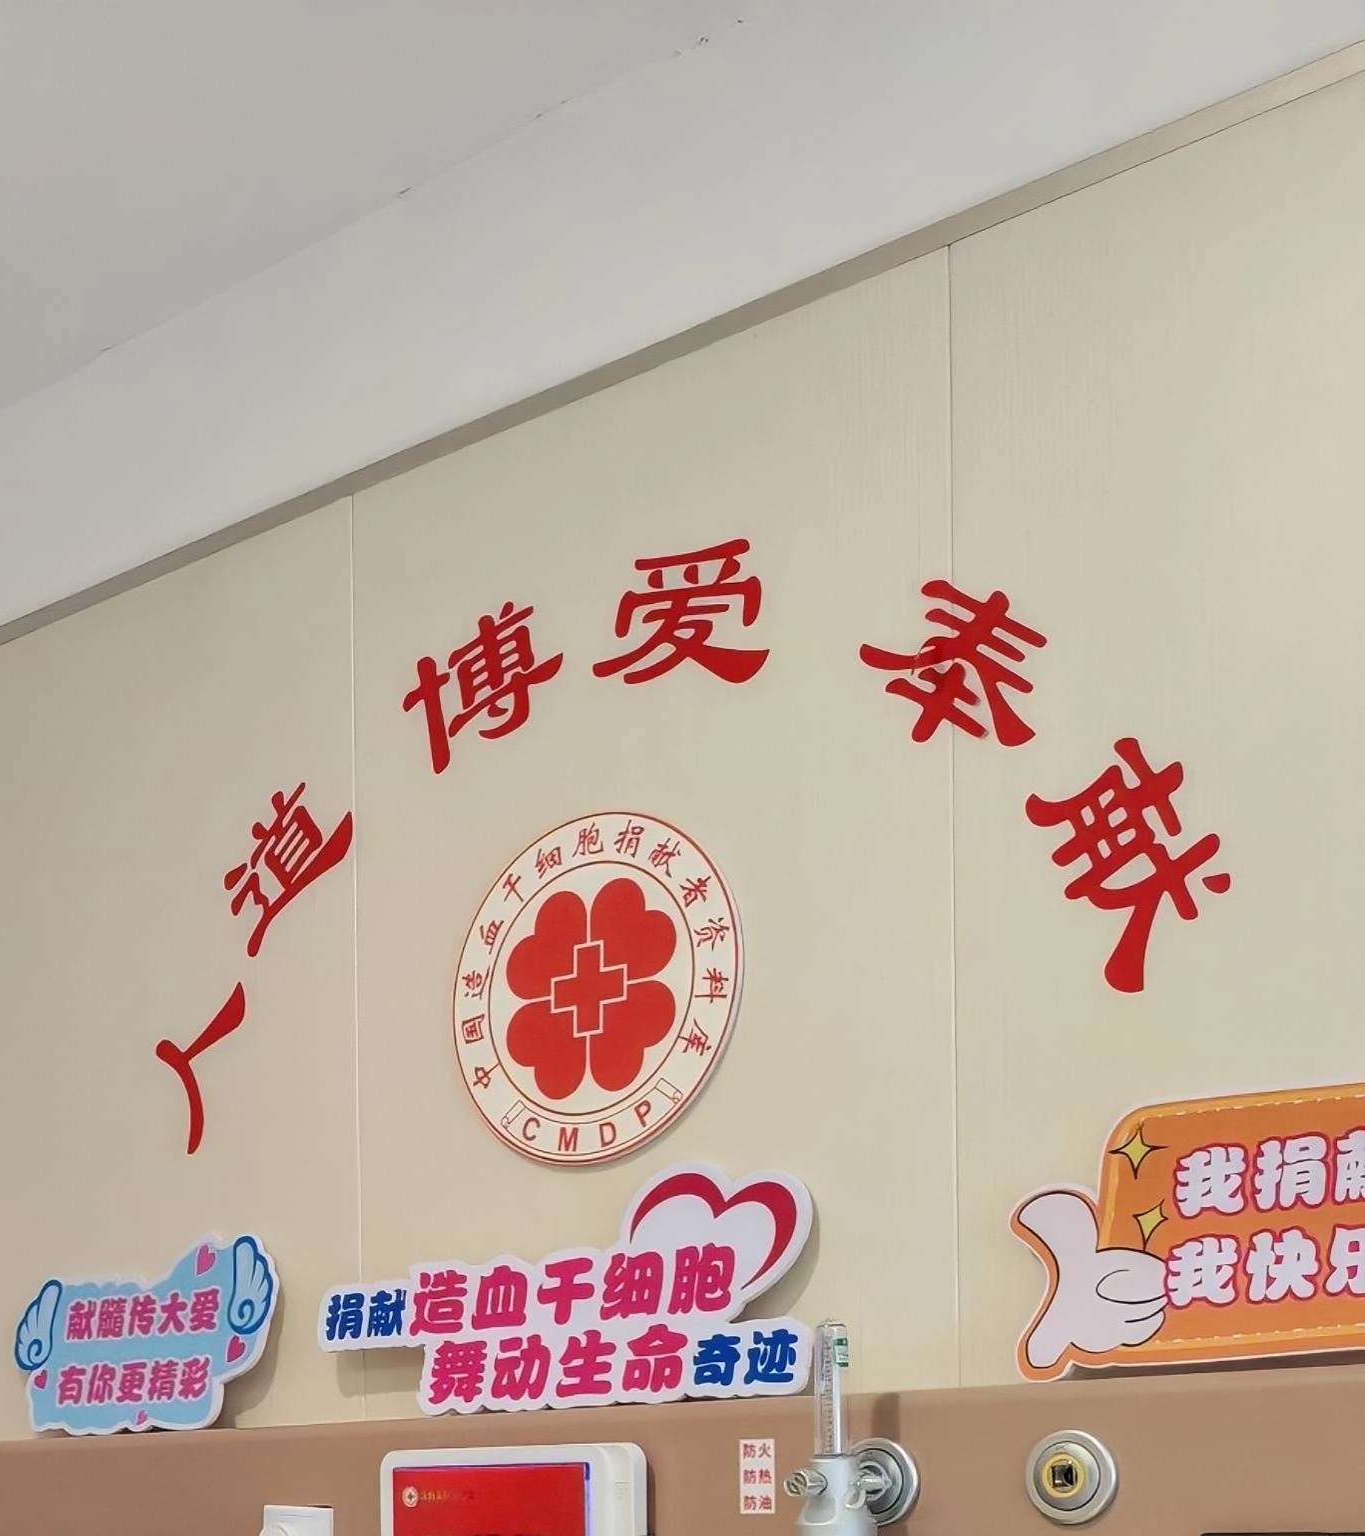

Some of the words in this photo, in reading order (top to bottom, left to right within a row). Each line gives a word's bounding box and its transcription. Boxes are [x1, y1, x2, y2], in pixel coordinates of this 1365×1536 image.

[460, 818, 731, 1090] 中国造血干细胞捐献者资料库
[521, 1099, 653, 1153] CMDP
[66, 1287, 221, 1341] 献髓传大爱
[325, 1242, 737, 1342] 捐献造血干细胞
[56, 1356, 211, 1406] 有你更精彩
[428, 1322, 800, 1405] 舞动生命奇迹
[742, 1443, 772, 1459] 防火
[742, 1468, 772, 1485] 防热
[742, 1494, 773, 1511] 防油
